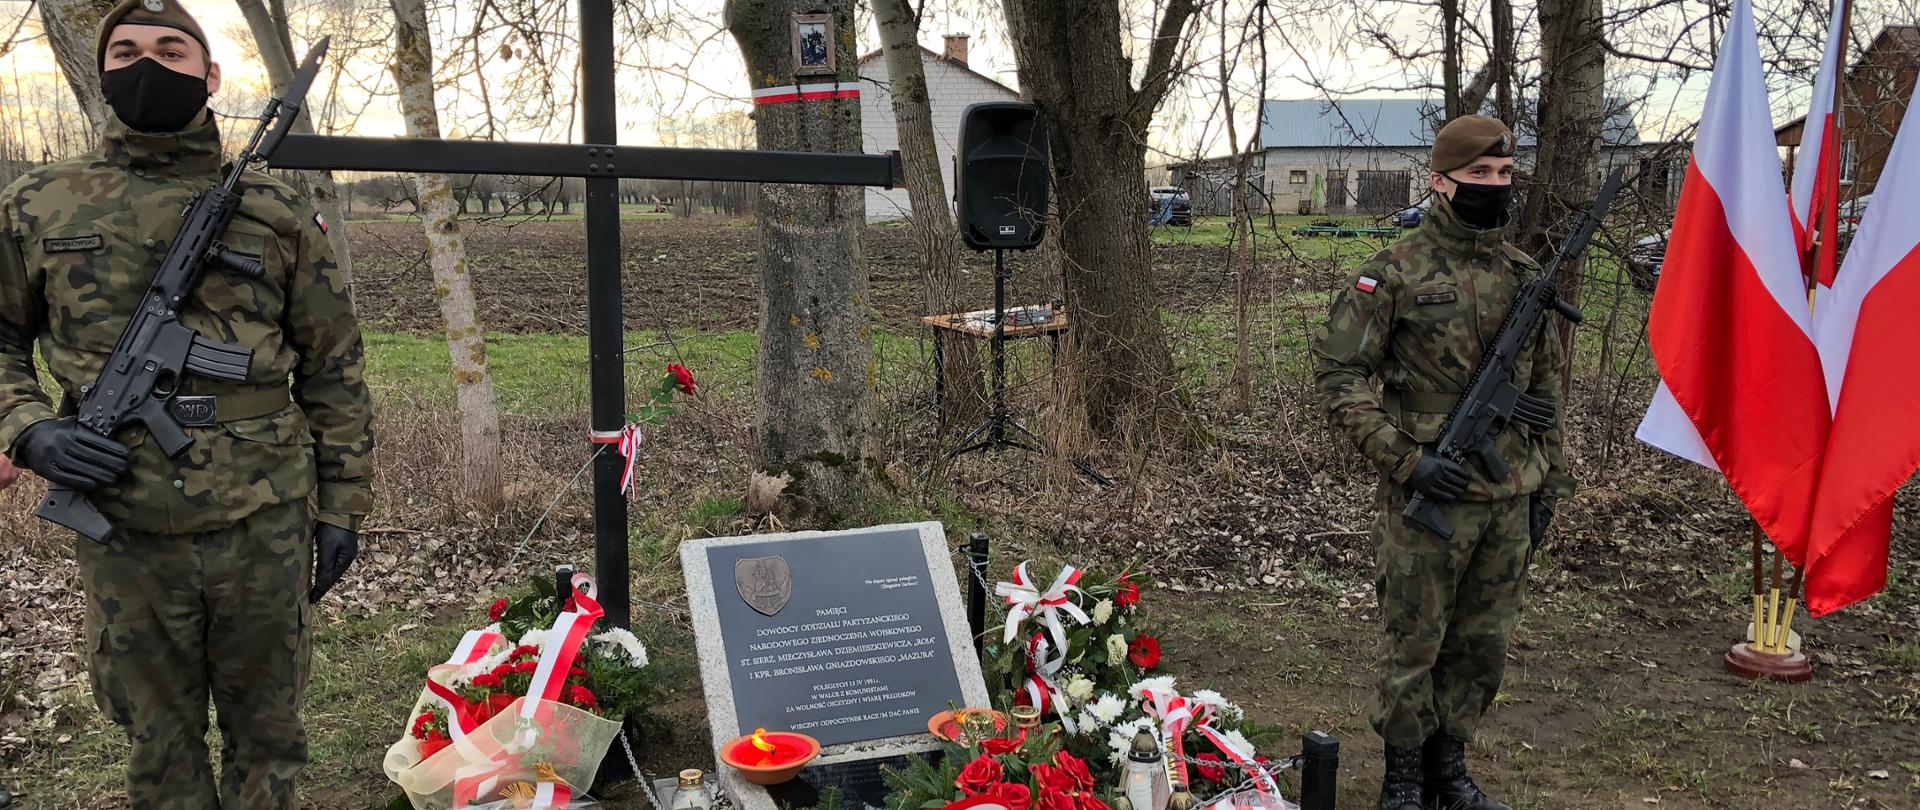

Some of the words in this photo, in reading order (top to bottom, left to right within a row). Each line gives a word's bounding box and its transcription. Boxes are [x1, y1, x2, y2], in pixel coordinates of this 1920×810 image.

[179, 404, 208, 417] WP
[816, 606, 848, 616] PAMIĘCI
[756, 625, 799, 637] DOWÓDCY
[800, 620, 840, 632] ODDZIAŁU
[842, 613, 910, 627] PARTYZANCKIEGO
[750, 638, 809, 652] NARODOWEGO
[811, 632, 868, 645] ZJEDNOCZENIA
[869, 625, 922, 638] WOJSKOWEGO
[740, 659, 752, 667] ST.
[778, 649, 833, 662] MIECZYSŁAWA
[834, 640, 912, 655] DZIEMIESZKIEWICZA
[774, 664, 824, 676] BRONISŁAWA
[826, 655, 896, 670] GNIAZDOWSKIEGO
[812, 681, 848, 691] POLEGŁYCH
[818, 691, 840, 699] WALCE
[846, 685, 888, 696] KOMUNISTAMI
[795, 701, 826, 711] WOLNOŚĆ
[882, 690, 916, 700] PRZODKÓW
[790, 720, 819, 730] WIECZNY
[820, 715, 862, 726] ODPOCZYNEK
[902, 707, 920, 715] PANIE
